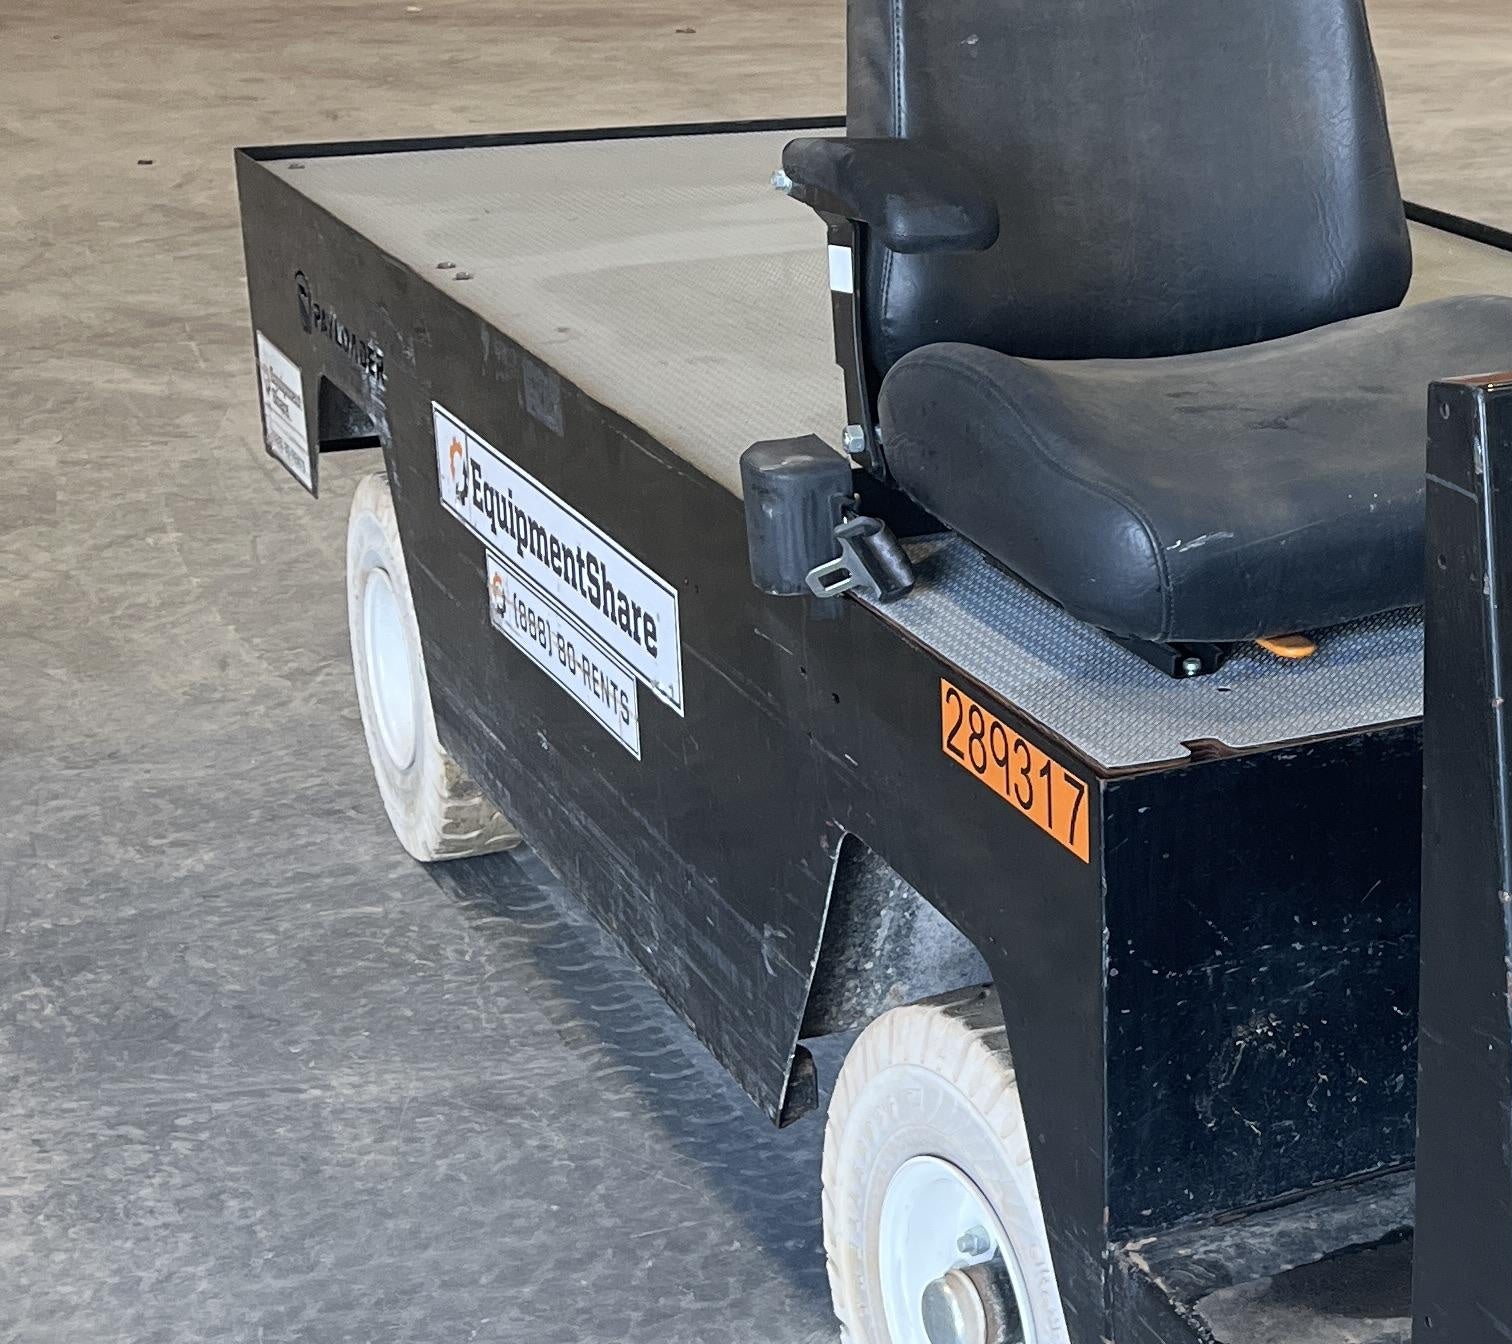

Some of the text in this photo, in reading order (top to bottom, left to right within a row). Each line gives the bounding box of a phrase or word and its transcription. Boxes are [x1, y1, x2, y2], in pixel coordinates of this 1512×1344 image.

[469, 457, 659, 660] EquipmentShare
[512, 592, 630, 726] (888) 80-RENTS
[945, 686, 1086, 846] 289317
